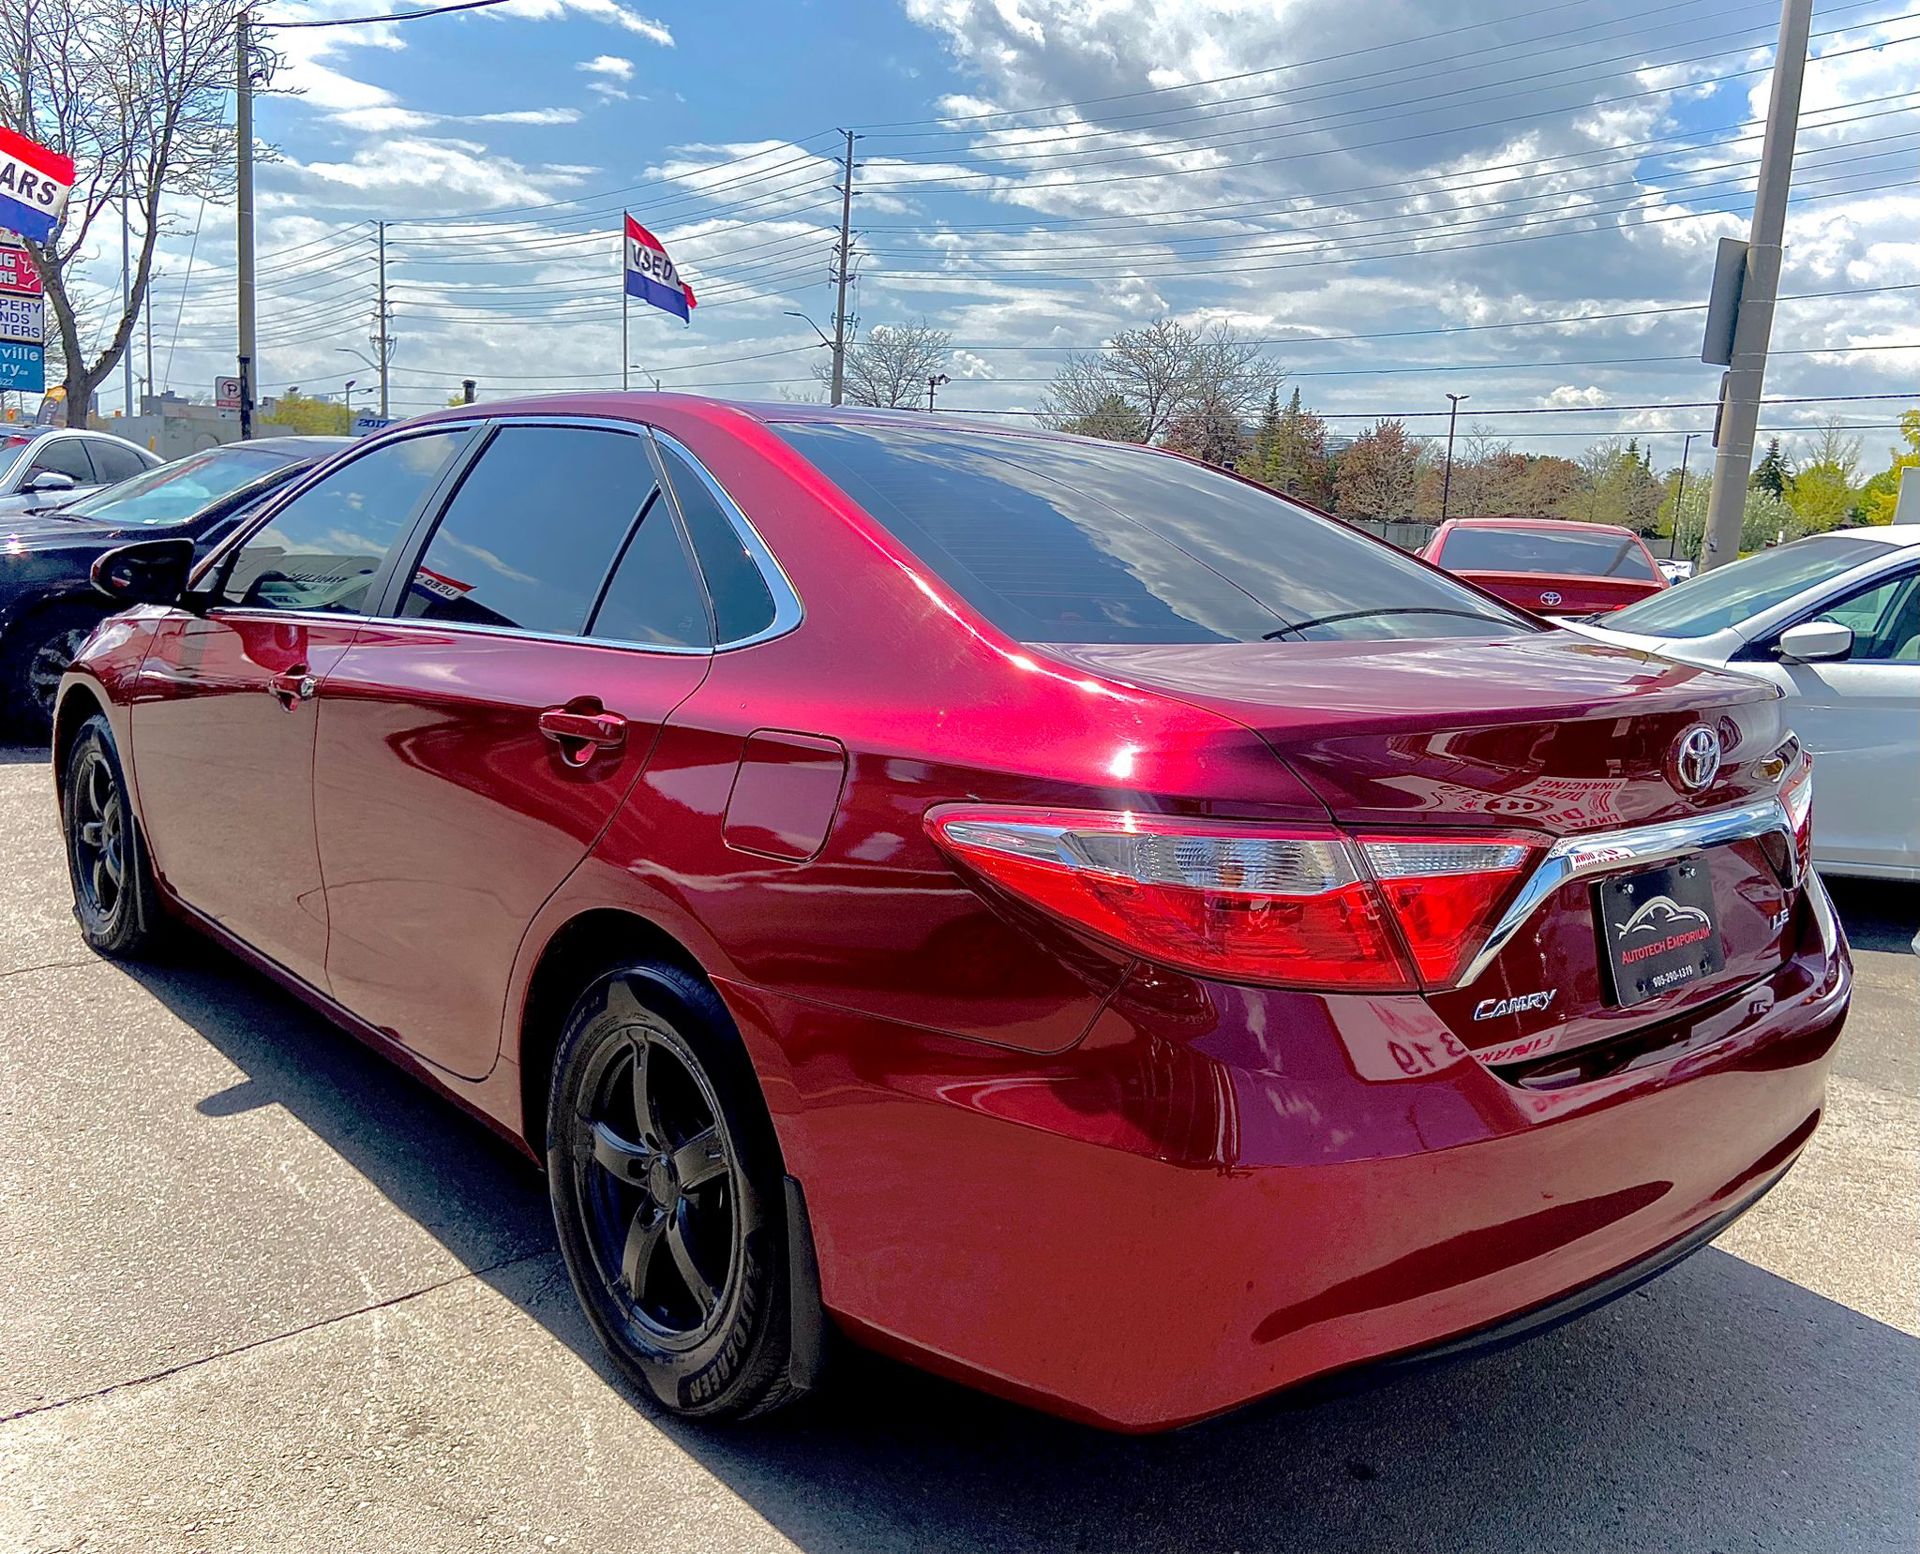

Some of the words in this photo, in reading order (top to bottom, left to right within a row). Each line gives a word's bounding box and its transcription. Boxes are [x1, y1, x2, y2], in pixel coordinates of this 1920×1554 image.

[0, 162, 57, 206] ARS
[632, 244, 673, 281] USED
[0, 298, 41, 314] PERY
[0, 311, 30, 325] NDS
[1, 323, 40, 338] TERS
[1, 346, 39, 361] ville
[358, 418, 389, 428] 2017
[1772, 908, 1790, 930] LE
[1621, 940, 1667, 965] AUTOTECH
[1666, 926, 1712, 951] EMPORIUM
[1474, 988, 1558, 1021] CAMRY
